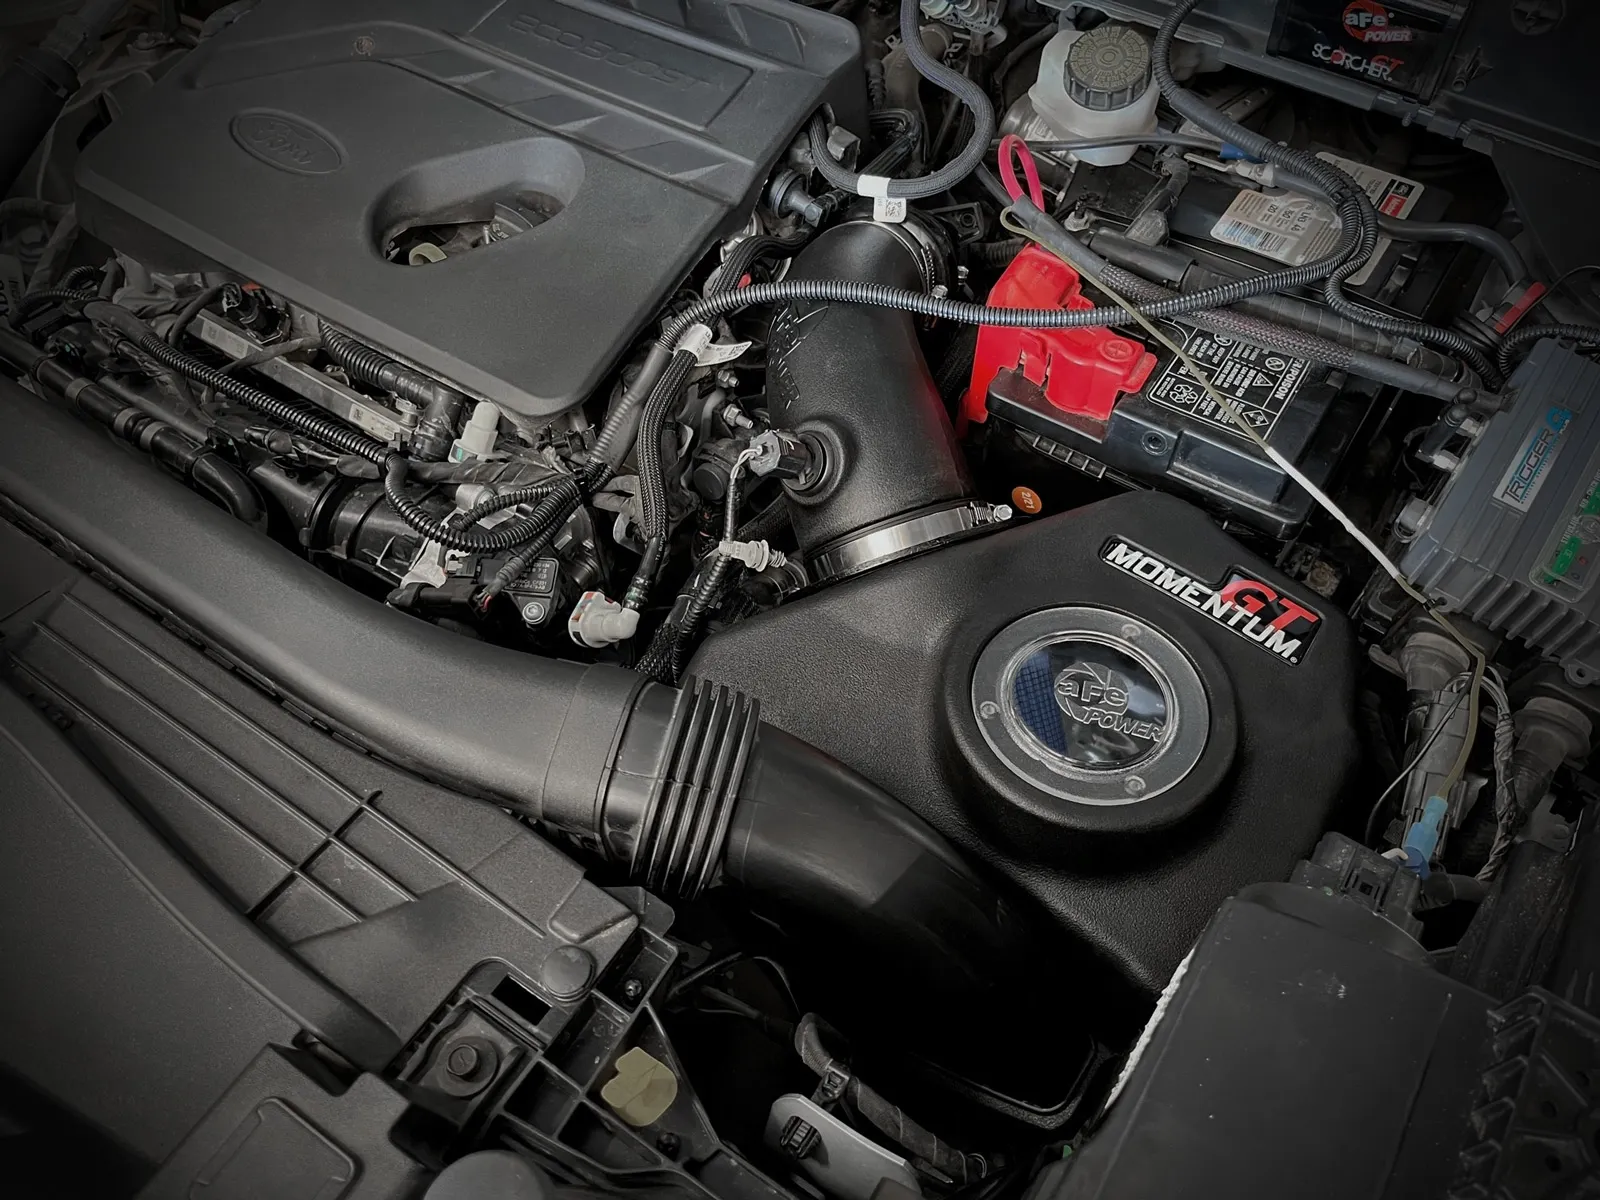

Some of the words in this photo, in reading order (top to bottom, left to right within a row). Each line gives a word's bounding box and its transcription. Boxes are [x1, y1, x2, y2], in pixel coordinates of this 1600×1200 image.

[1344, 12, 1387, 28] aFe
[1364, 29, 1412, 42] POWER
[1312, 43, 1390, 81] SCORCHER
[1371, 55, 1404, 73] GT
[1501, 427, 1554, 503] TRIGGER
[1021, 491, 1035, 509] 2/21
[1106, 542, 1302, 659] MOMENTUM
[1220, 579, 1319, 633] GT
[1057, 680, 1128, 707] aFe
[1082, 706, 1165, 742] POWER
